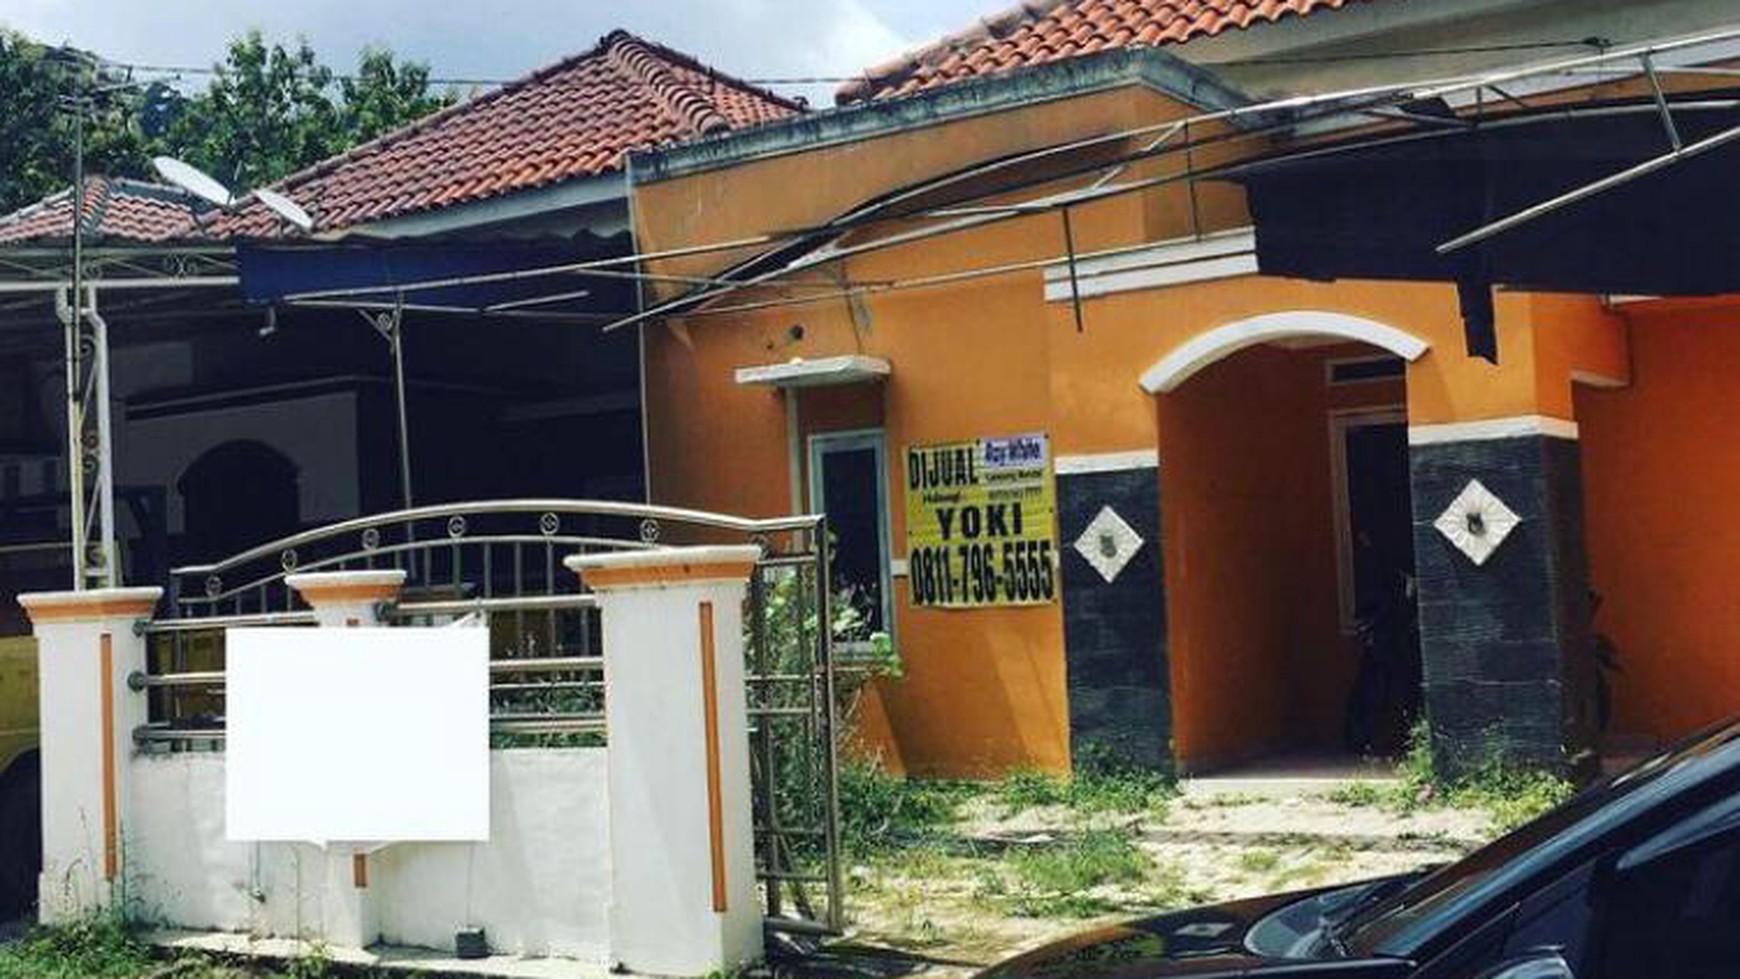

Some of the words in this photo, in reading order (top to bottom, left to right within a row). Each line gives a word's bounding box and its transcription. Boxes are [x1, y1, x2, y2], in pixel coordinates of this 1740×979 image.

[909, 447, 979, 489] DIJUAL
[936, 502, 1022, 540] YOKI
[911, 540, 1053, 605] 0811-796-5555
